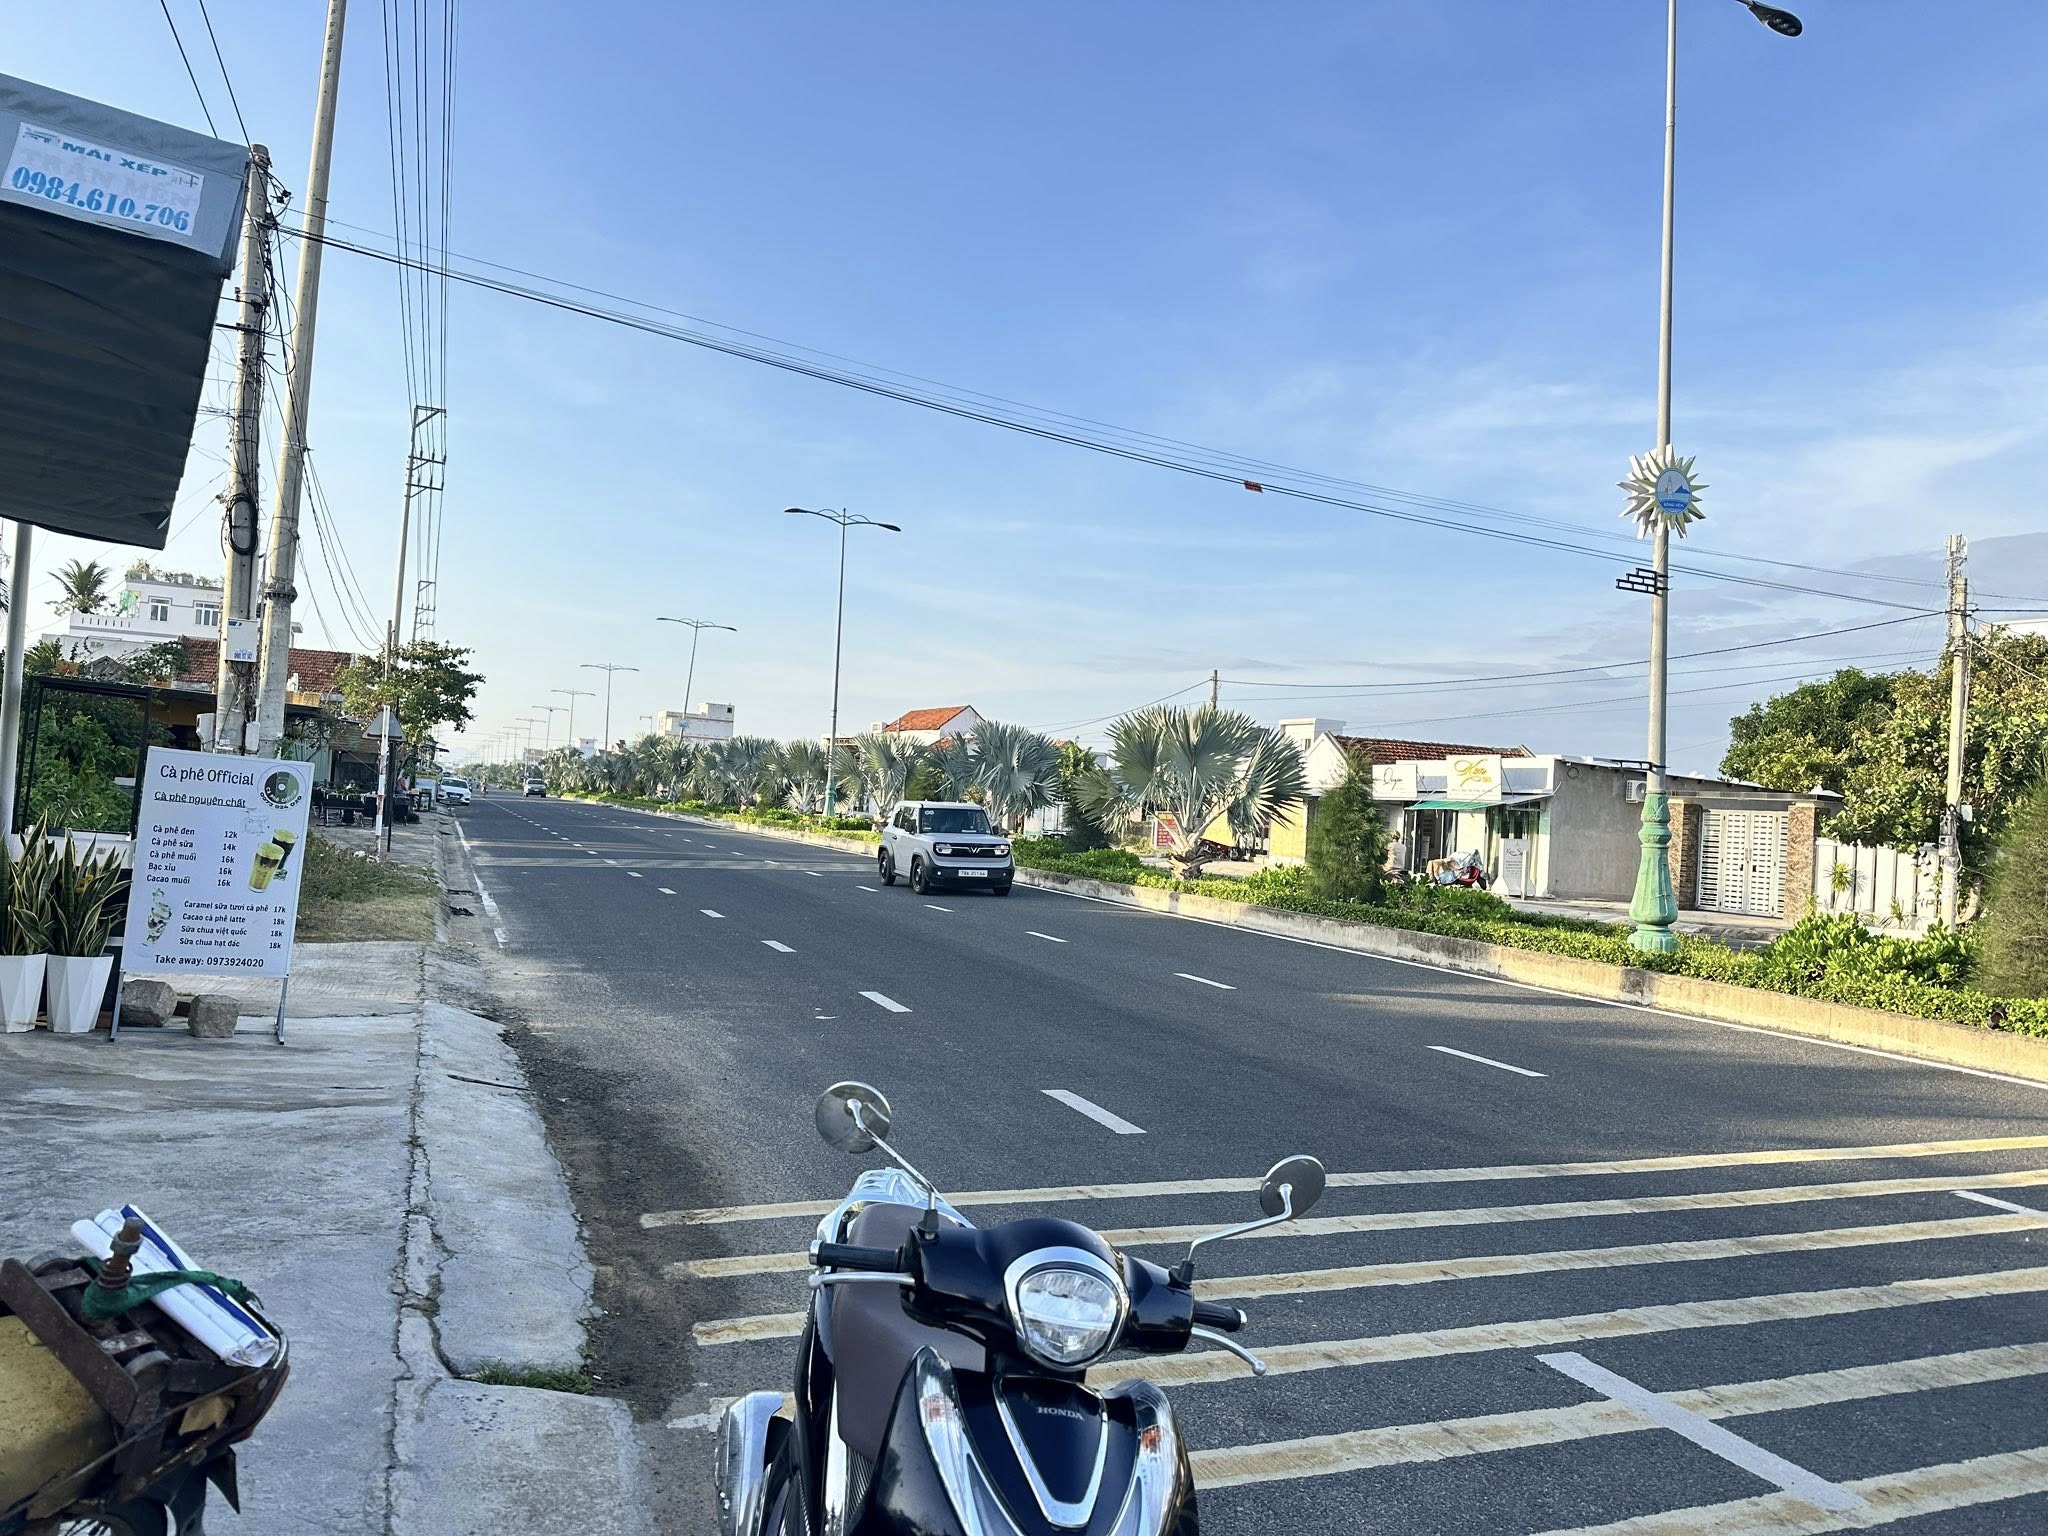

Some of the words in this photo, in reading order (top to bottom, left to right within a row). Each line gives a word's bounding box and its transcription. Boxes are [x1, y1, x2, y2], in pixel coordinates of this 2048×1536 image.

[12, 166, 189, 231] 0984.610.706
[161, 765, 177, 779] Cà
[180, 767, 204, 782] phê
[208, 769, 254, 786] Official
[154, 791, 166, 800] Cà
[169, 793, 187, 803] phê
[189, 795, 223, 806] nguyên
[226, 797, 245, 808] chất
[164, 826, 178, 834] phê
[181, 827, 195, 835] đen
[163, 839, 177, 847] phê
[179, 840, 193, 848] sữa
[150, 850, 159, 858] Cà
[178, 853, 196, 861] muối
[147, 875, 169, 883] Cacao
[171, 876, 190, 884] muối
[184, 901, 213, 909] Caramel
[182, 913, 203, 921] Cacao
[155, 955, 176, 964] Take
[179, 957, 204, 966] away:
[207, 957, 264, 967] 0973924020
[1037, 1406, 1085, 1421] HONDA
